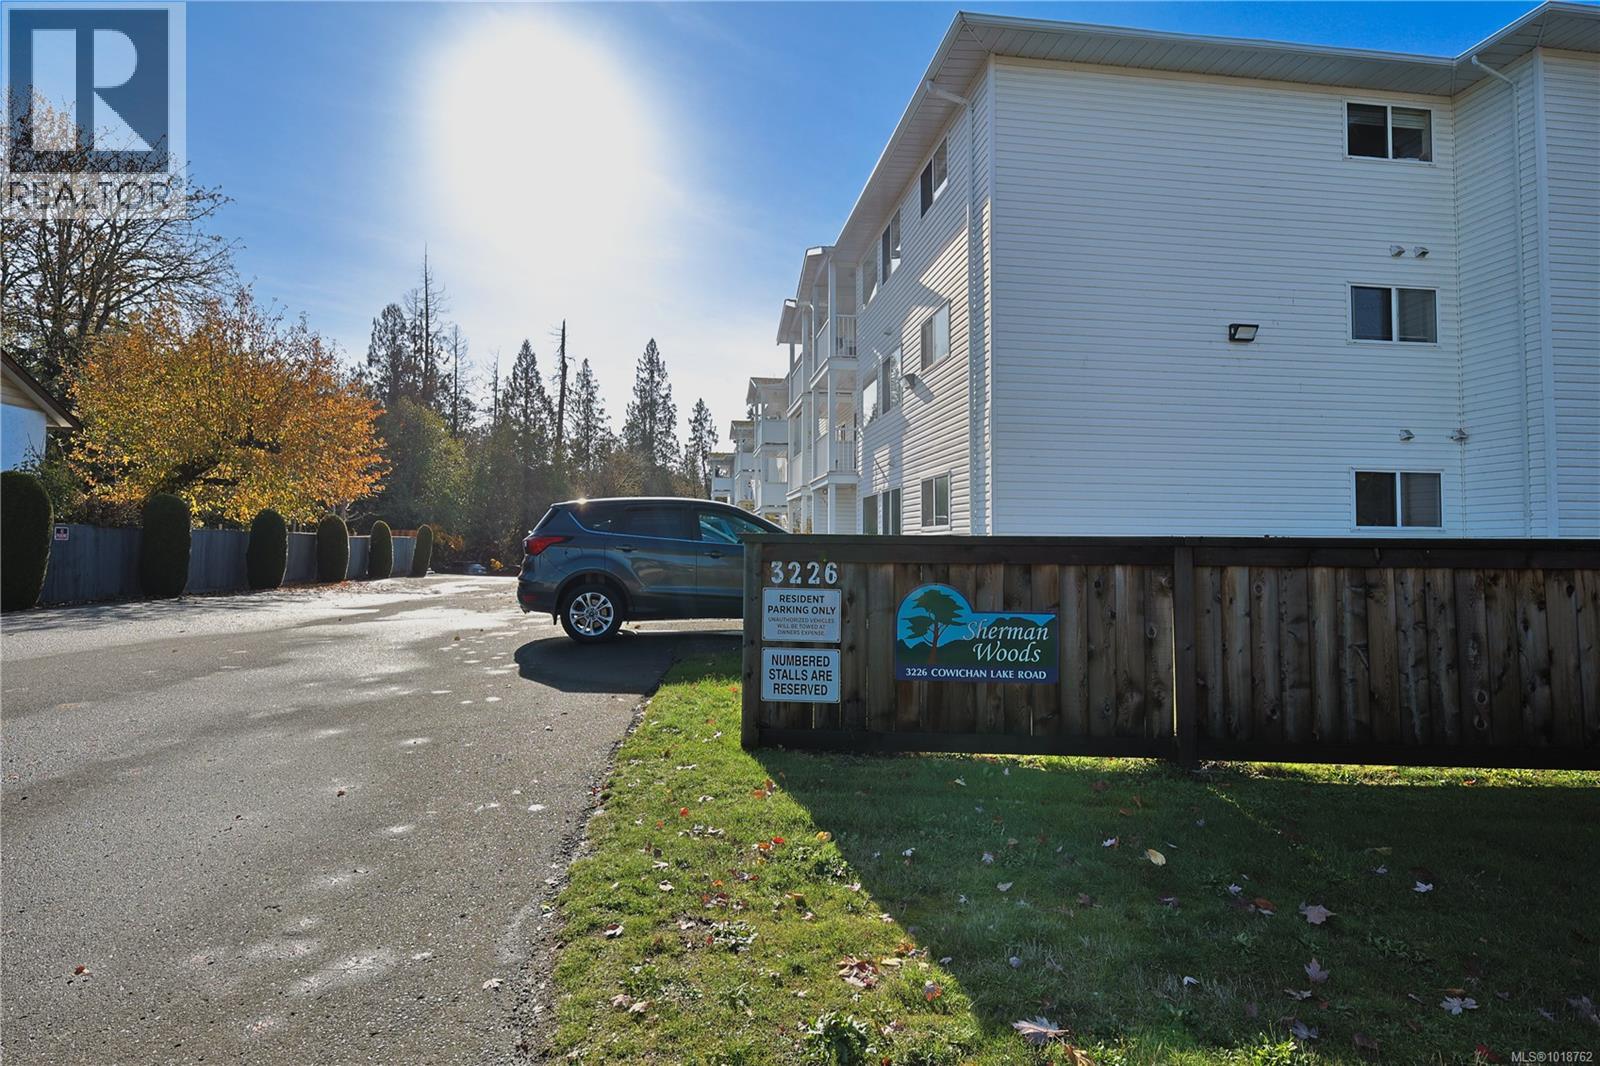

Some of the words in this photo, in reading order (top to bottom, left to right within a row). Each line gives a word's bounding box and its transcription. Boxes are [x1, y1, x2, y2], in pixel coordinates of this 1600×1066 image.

[770, 560, 838, 585] 3226
[779, 594, 825, 603] RESIDENT
[767, 605, 809, 614] PARKING
[811, 606, 836, 615] ONLY
[962, 618, 1049, 641] Sherman
[972, 641, 1041, 663] Woods
[771, 654, 830, 667] NUMBERED
[768, 668, 808, 681] STALLS
[811, 670, 833, 682] ARE
[905, 667, 928, 677] 3226
[931, 668, 987, 678] COWICHAN
[990, 670, 1014, 679] LAKE
[1018, 670, 1046, 680] ROAD
[773, 683, 828, 696] RESERVED
